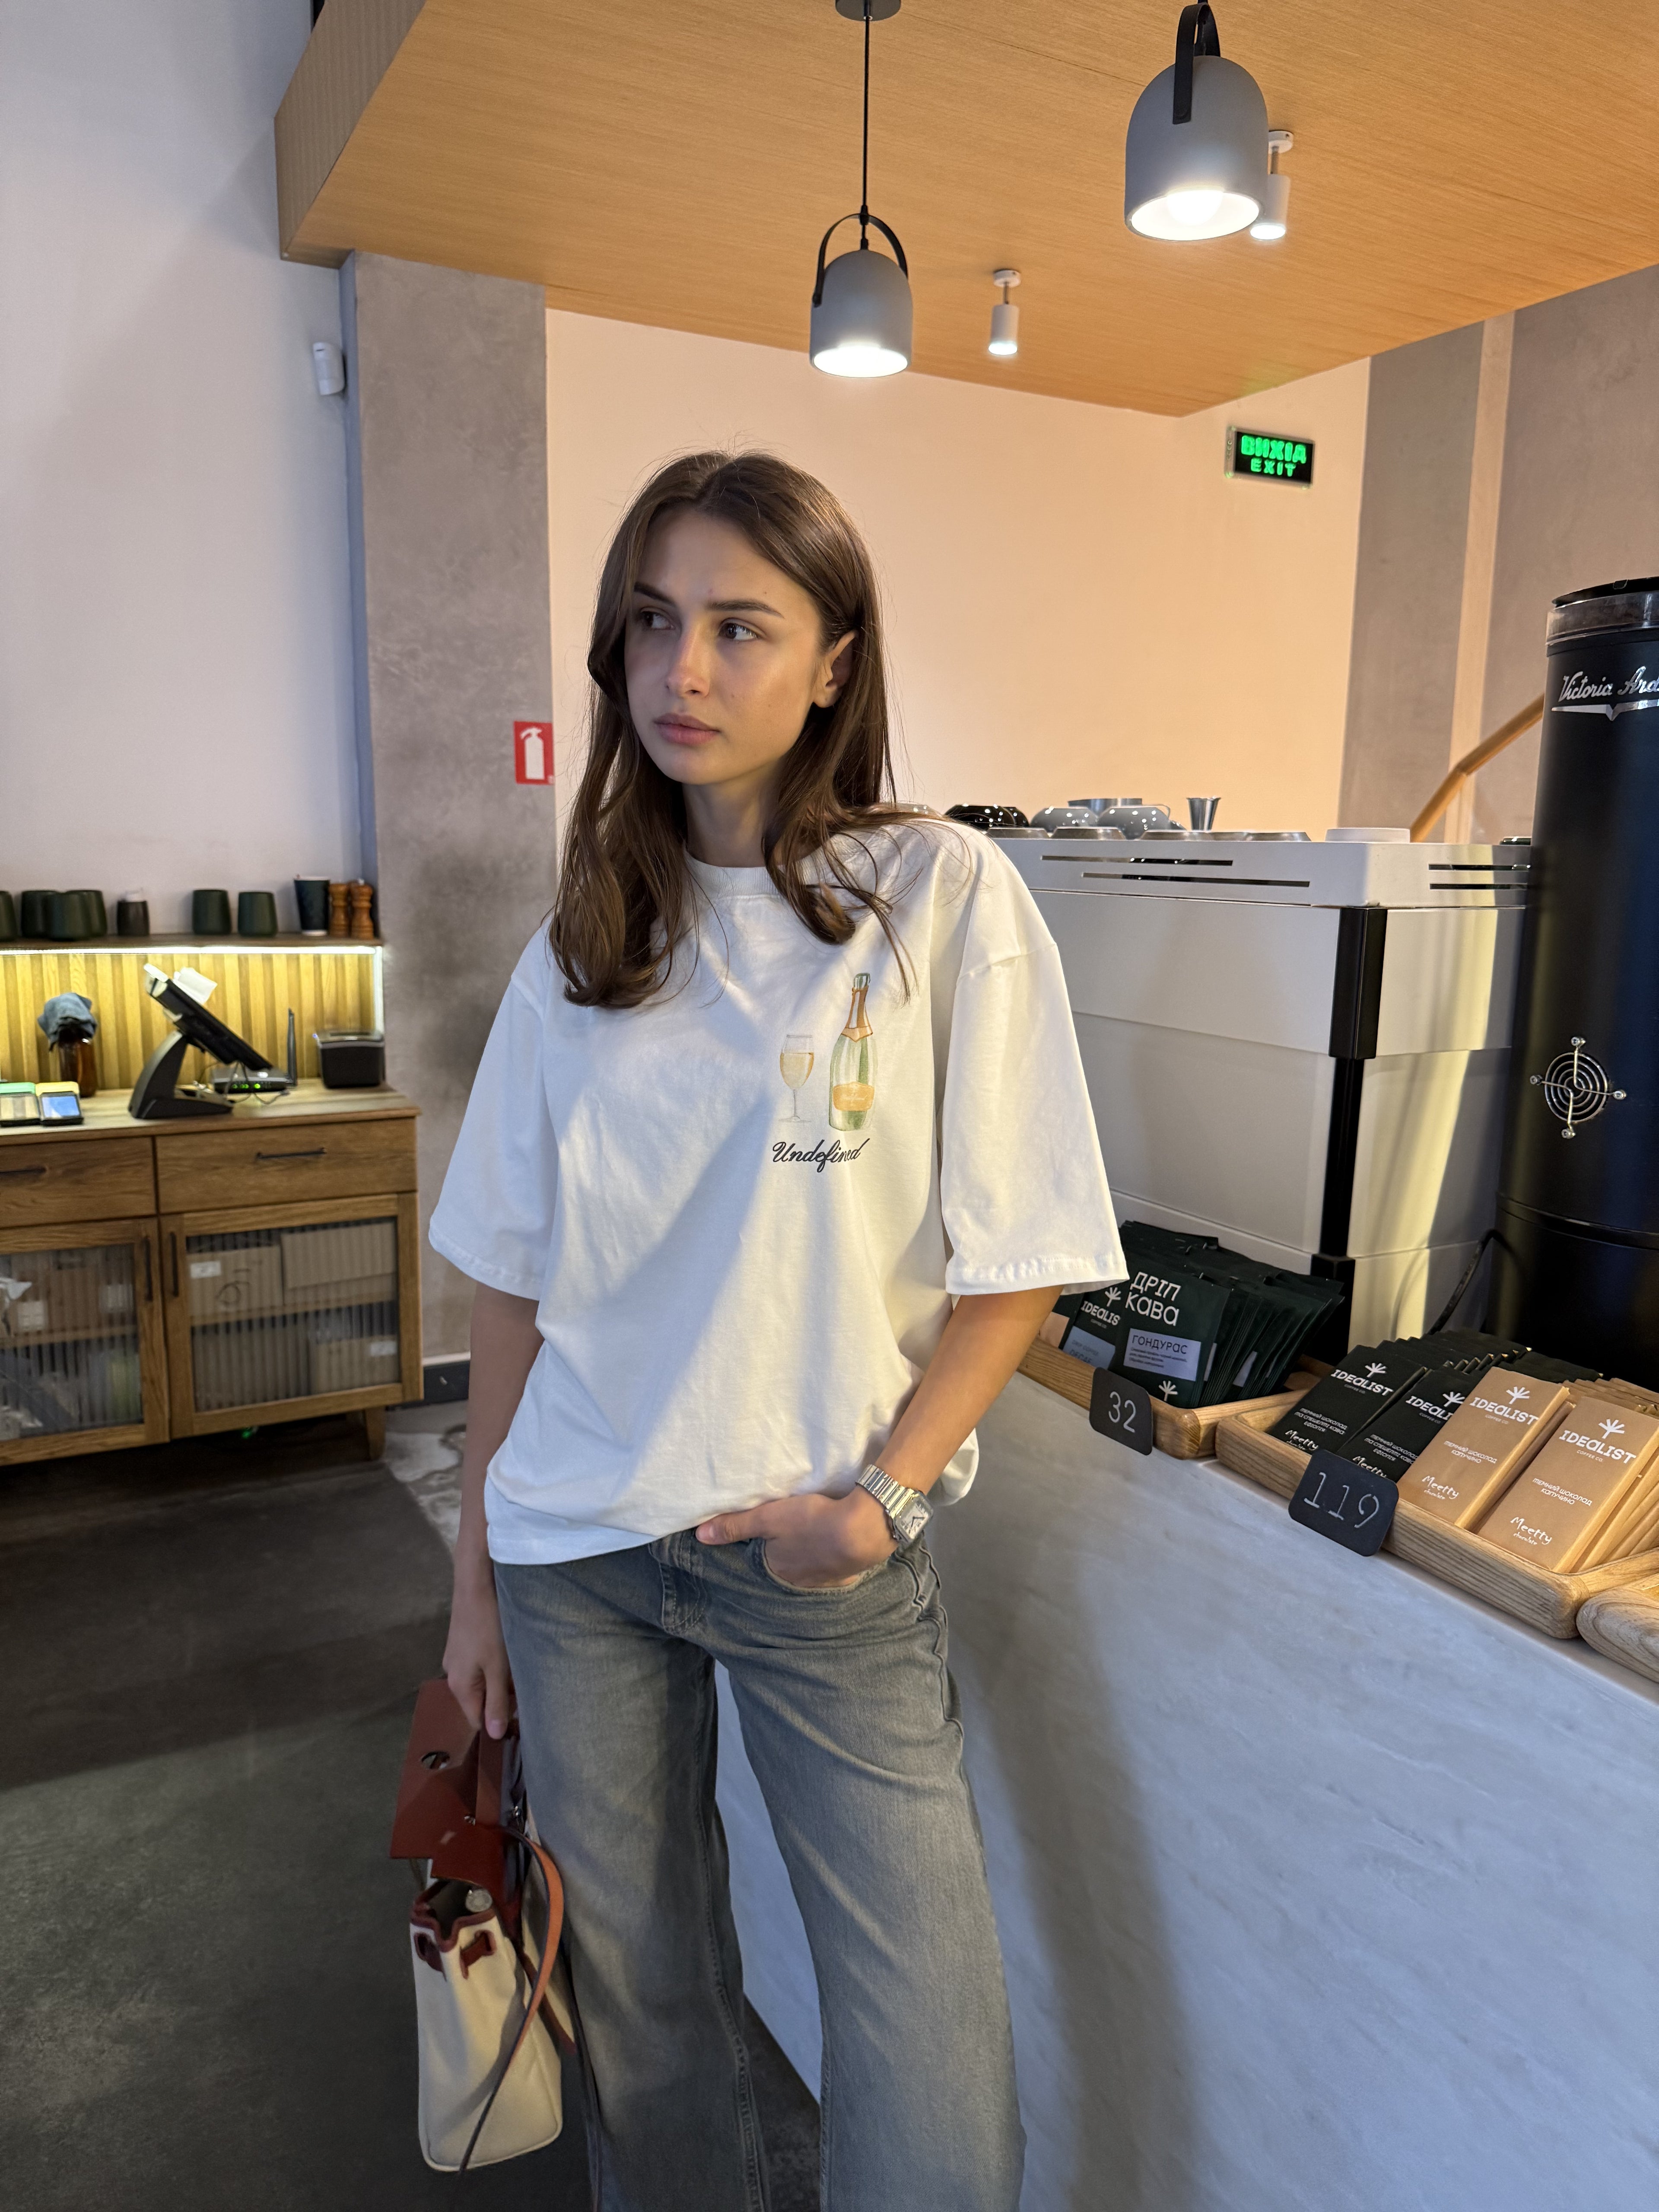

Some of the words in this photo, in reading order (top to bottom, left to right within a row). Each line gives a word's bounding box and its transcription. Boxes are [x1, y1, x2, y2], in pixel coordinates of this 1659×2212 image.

[1241, 435, 1306, 464] ВИХІД
[1251, 458, 1296, 477] EXIT
[1558, 671, 1613, 702] Victoria
[1617, 666, 1659, 694] Ard
[772, 1138, 870, 1173] Undefined
[1130, 1271, 1182, 1301] ДРІП
[1081, 1300, 1121, 1326] IDEALIS
[1132, 1335, 1188, 1354] ГОНДУРАС
[1108, 1391, 1136, 1433] 32
[1406, 1395, 1454, 1421] IDEALI
[1285, 1430, 1319, 1451] Meetty
[1303, 1472, 1379, 1529] 119
[1422, 1475, 1459, 1500] Meetty
[1510, 1516, 1552, 1545] Meetty
[1513, 1532, 1538, 1545] chocolate
